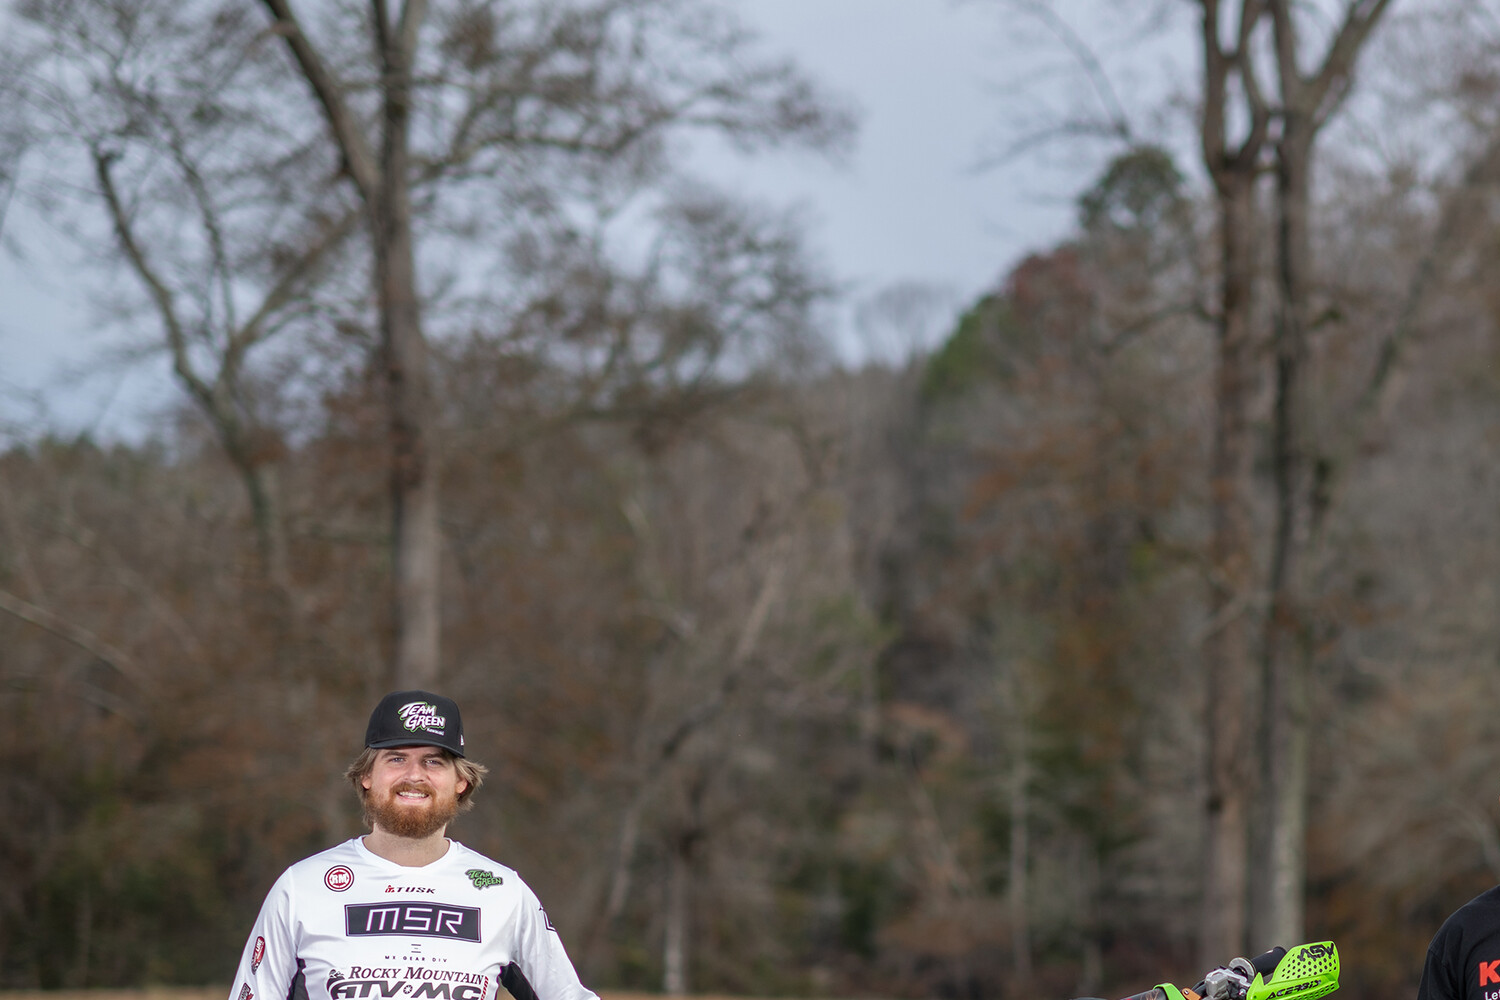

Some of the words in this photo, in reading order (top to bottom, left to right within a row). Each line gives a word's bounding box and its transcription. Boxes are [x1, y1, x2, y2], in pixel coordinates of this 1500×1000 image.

[399, 702, 437, 719] TEAM
[404, 715, 446, 732] GREEN
[466, 869, 493, 881] TEAM
[474, 877, 502, 889] GREEN
[396, 886, 436, 894] TUSK
[366, 907, 464, 934] MSR
[1299, 942, 1335, 962] ASV
[349, 966, 402, 980] ROCKY
[403, 966, 485, 986] MOUNTAIN
[1265, 979, 1321, 1000] ACERBIS
